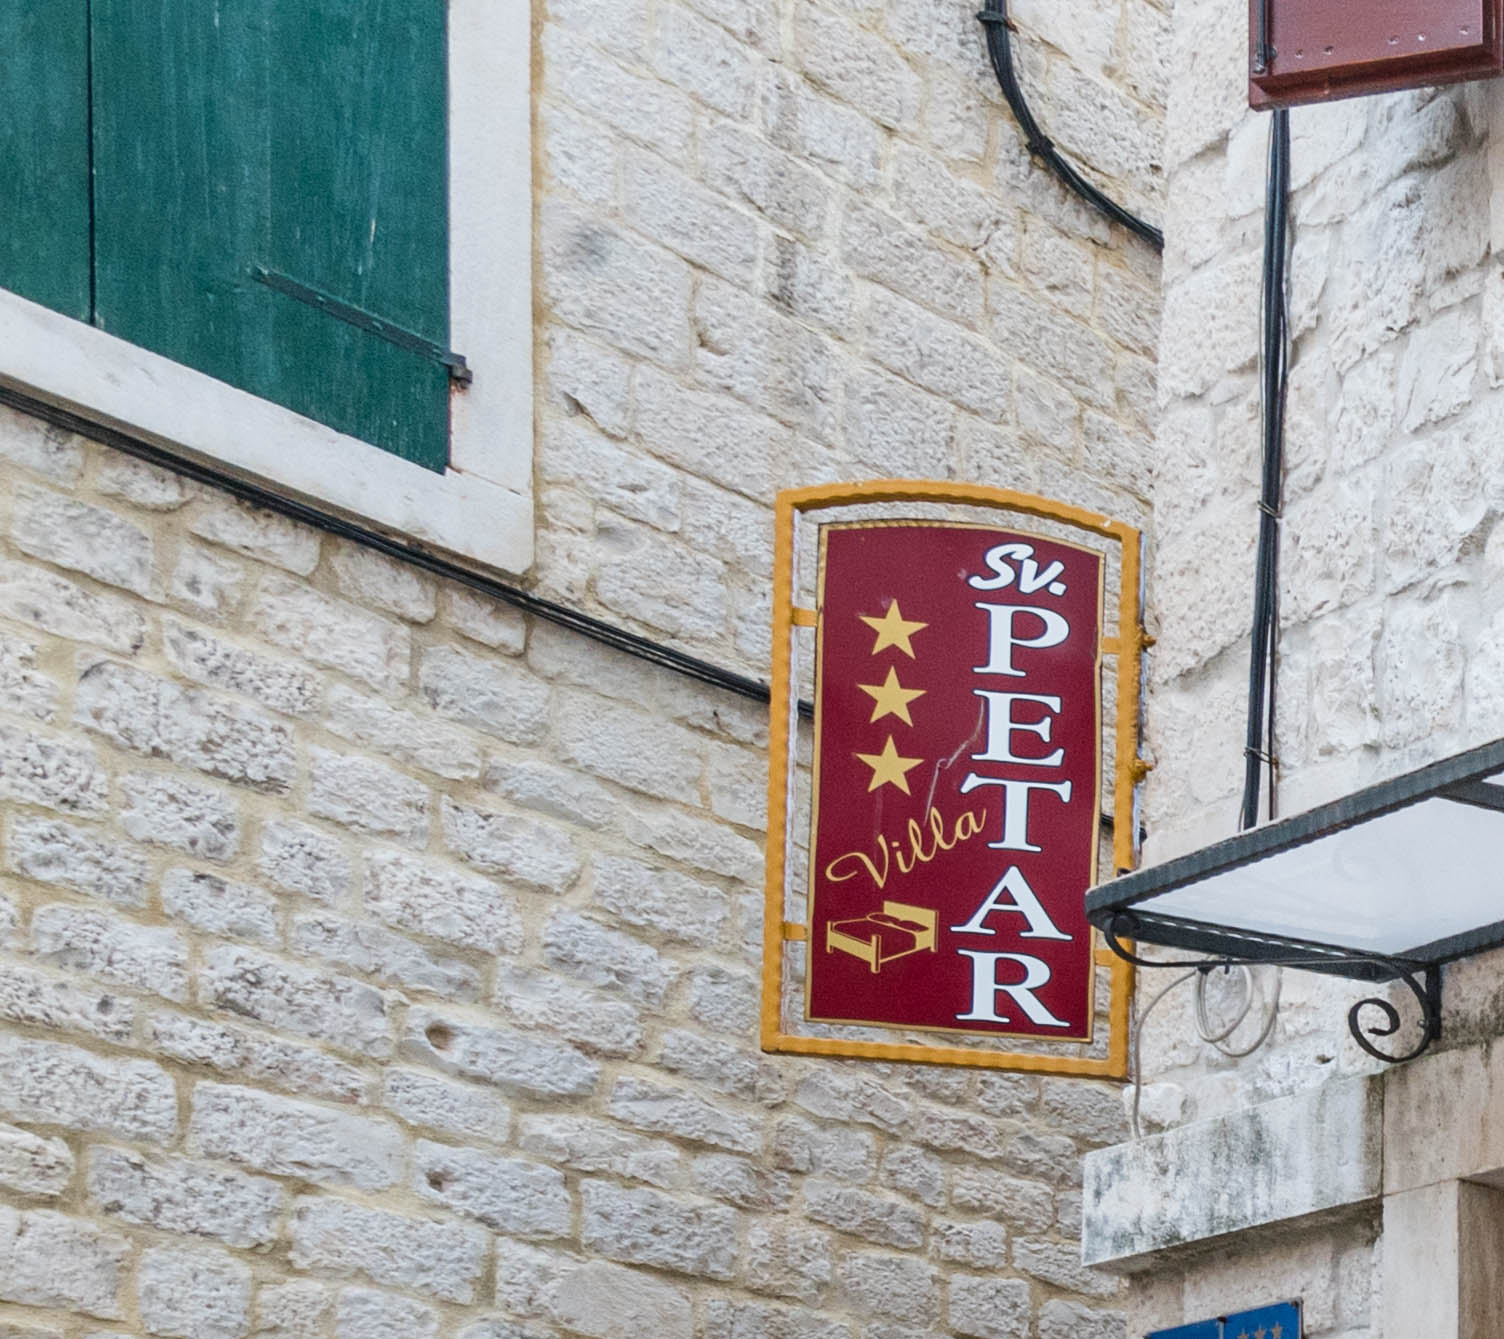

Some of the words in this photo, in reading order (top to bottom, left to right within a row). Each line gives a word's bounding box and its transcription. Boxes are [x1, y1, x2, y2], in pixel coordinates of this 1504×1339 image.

[967, 542, 1068, 596] Sv.
[825, 807, 987, 889] Villa
[950, 601, 1073, 1028] PETAR
